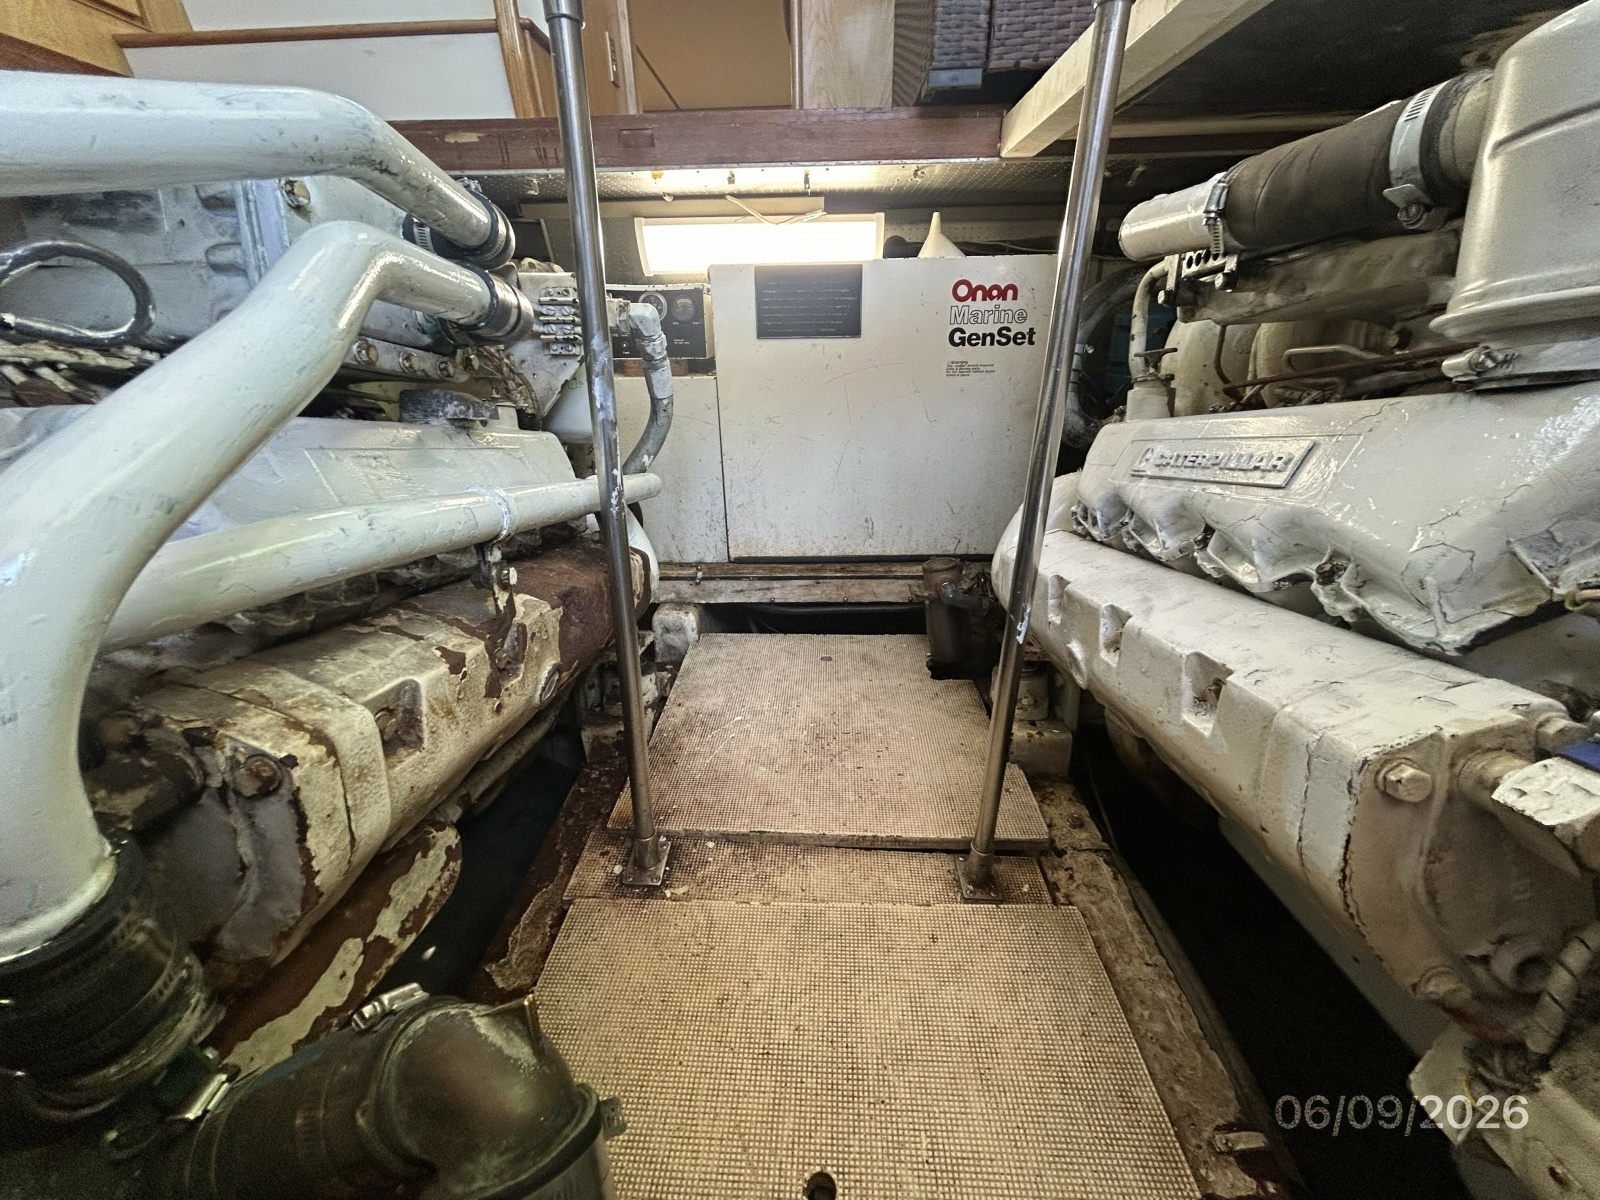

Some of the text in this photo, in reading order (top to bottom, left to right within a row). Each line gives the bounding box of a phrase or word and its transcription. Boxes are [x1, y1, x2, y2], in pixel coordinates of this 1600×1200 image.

[952, 279, 1018, 302] Onan
[950, 304, 1028, 325] Marine
[948, 326, 1036, 347] GenSet
[1154, 451, 1295, 473] CATERPILLAR
